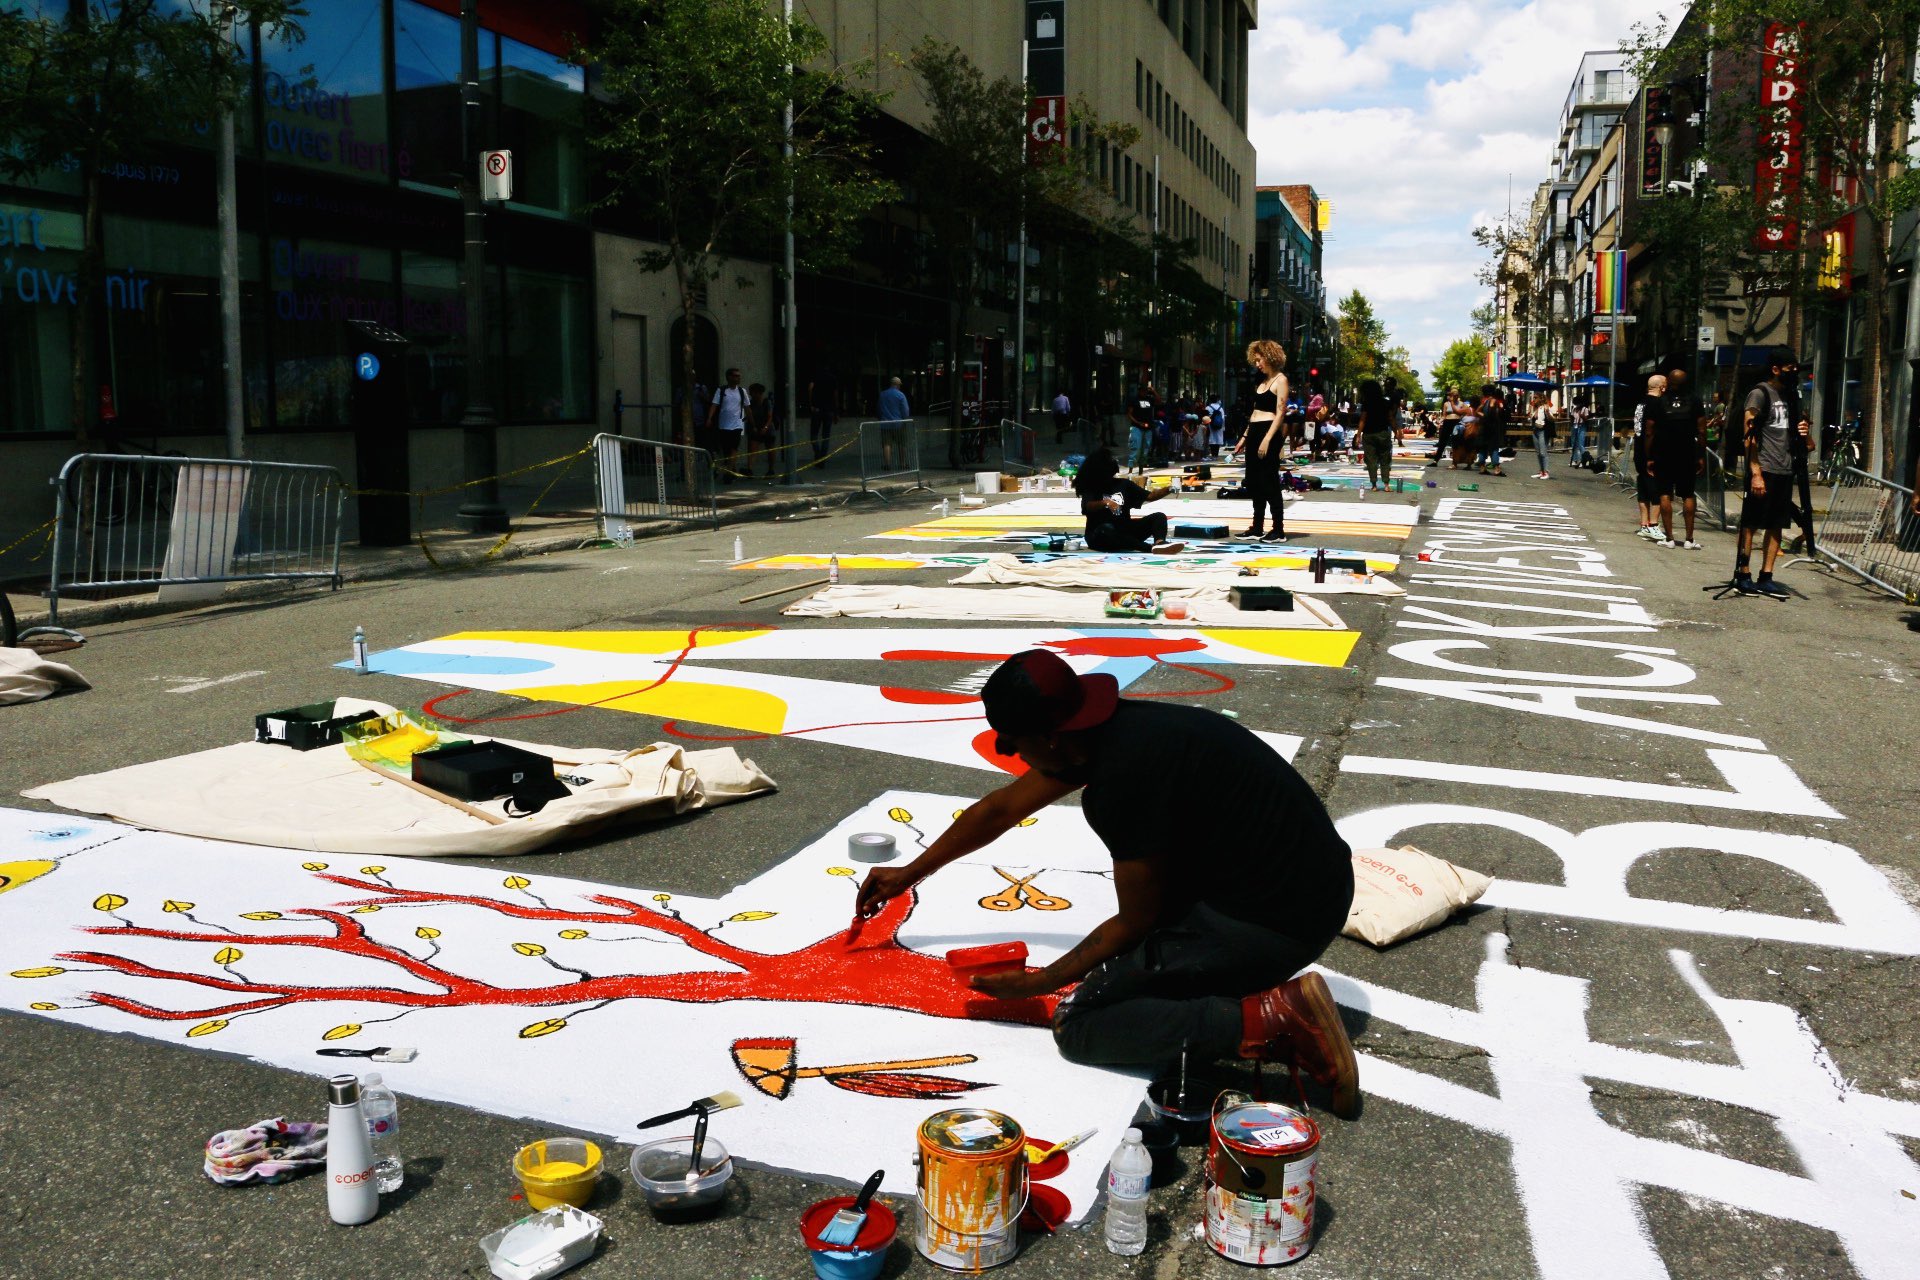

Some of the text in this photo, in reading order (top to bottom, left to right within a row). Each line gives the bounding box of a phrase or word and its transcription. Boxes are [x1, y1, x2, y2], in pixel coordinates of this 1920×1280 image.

[265, 71, 352, 125] Ouvert
[266, 120, 415, 178] avec fierté
[274, 239, 360, 287] Ouvert
[276, 290, 324, 321] aux
